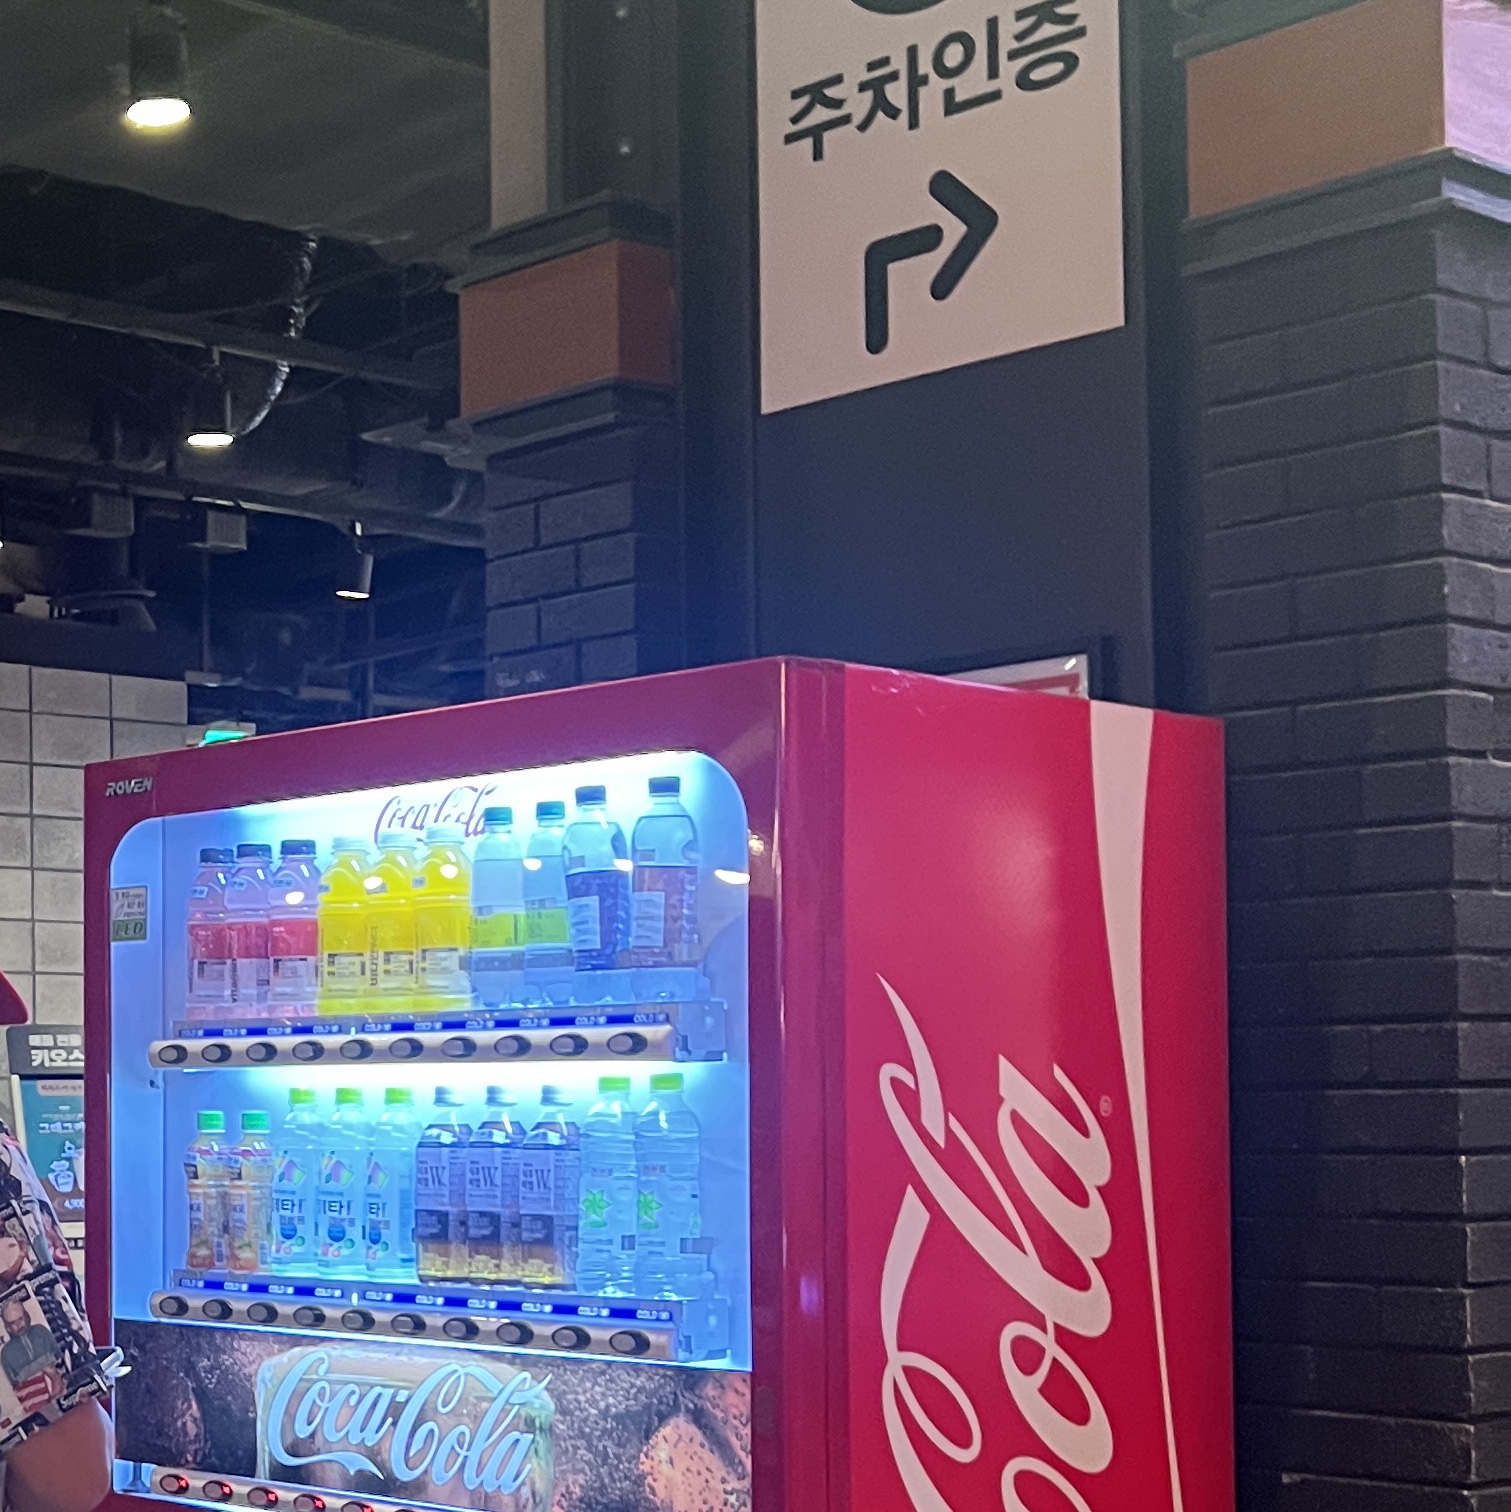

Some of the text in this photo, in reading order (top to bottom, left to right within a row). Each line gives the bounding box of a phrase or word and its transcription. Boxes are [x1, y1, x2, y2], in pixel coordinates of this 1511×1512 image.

[784, 0, 1088, 162] 주차인증
[106, 777, 153, 796] ROVEN
[268, 1350, 551, 1493] Coca-Cola
